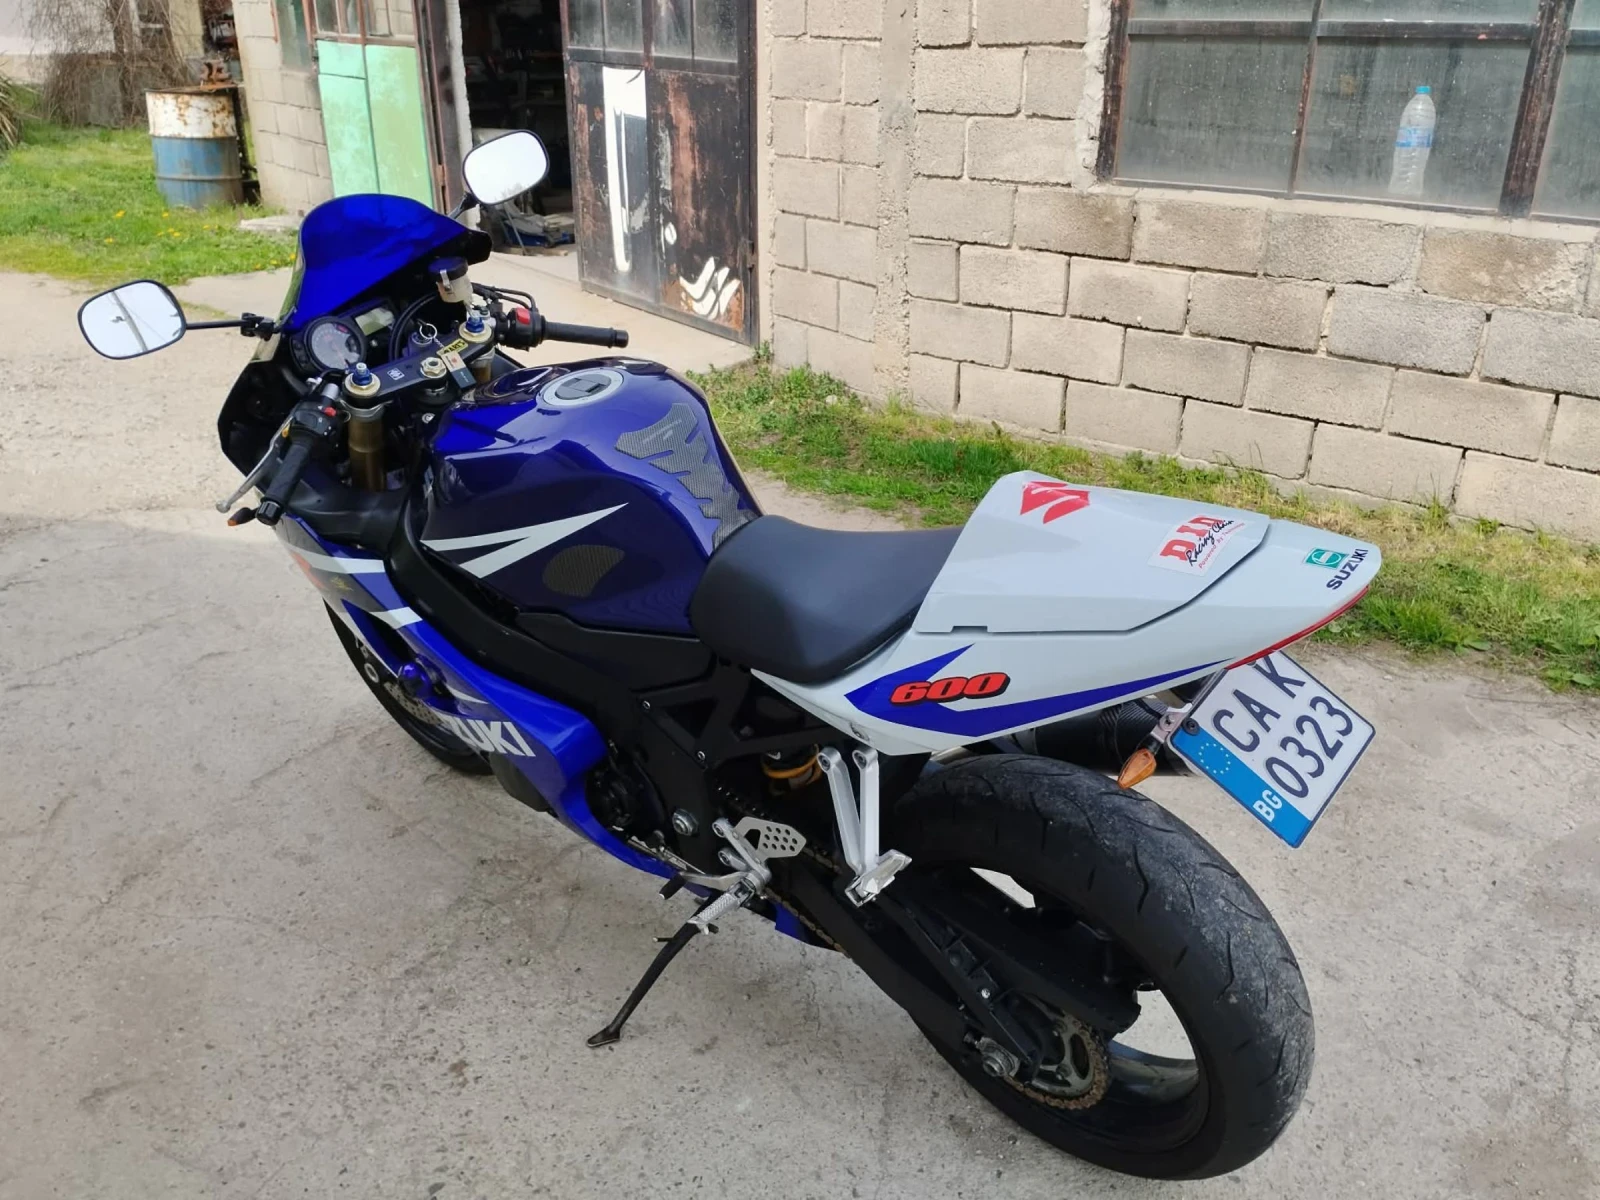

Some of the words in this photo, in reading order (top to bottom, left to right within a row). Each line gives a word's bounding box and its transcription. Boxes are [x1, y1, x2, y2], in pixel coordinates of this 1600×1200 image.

[1160, 516, 1224, 562] DID
[1185, 530, 1216, 567] Racing
[1211, 519, 1235, 533] Chain
[1326, 548, 1369, 591] SUZUKI
[889, 671, 1011, 707] 600
[1212, 688, 1281, 752] CA
[1253, 655, 1306, 699] K
[1265, 695, 1353, 798] 0323
[1252, 789, 1283, 823] BG
